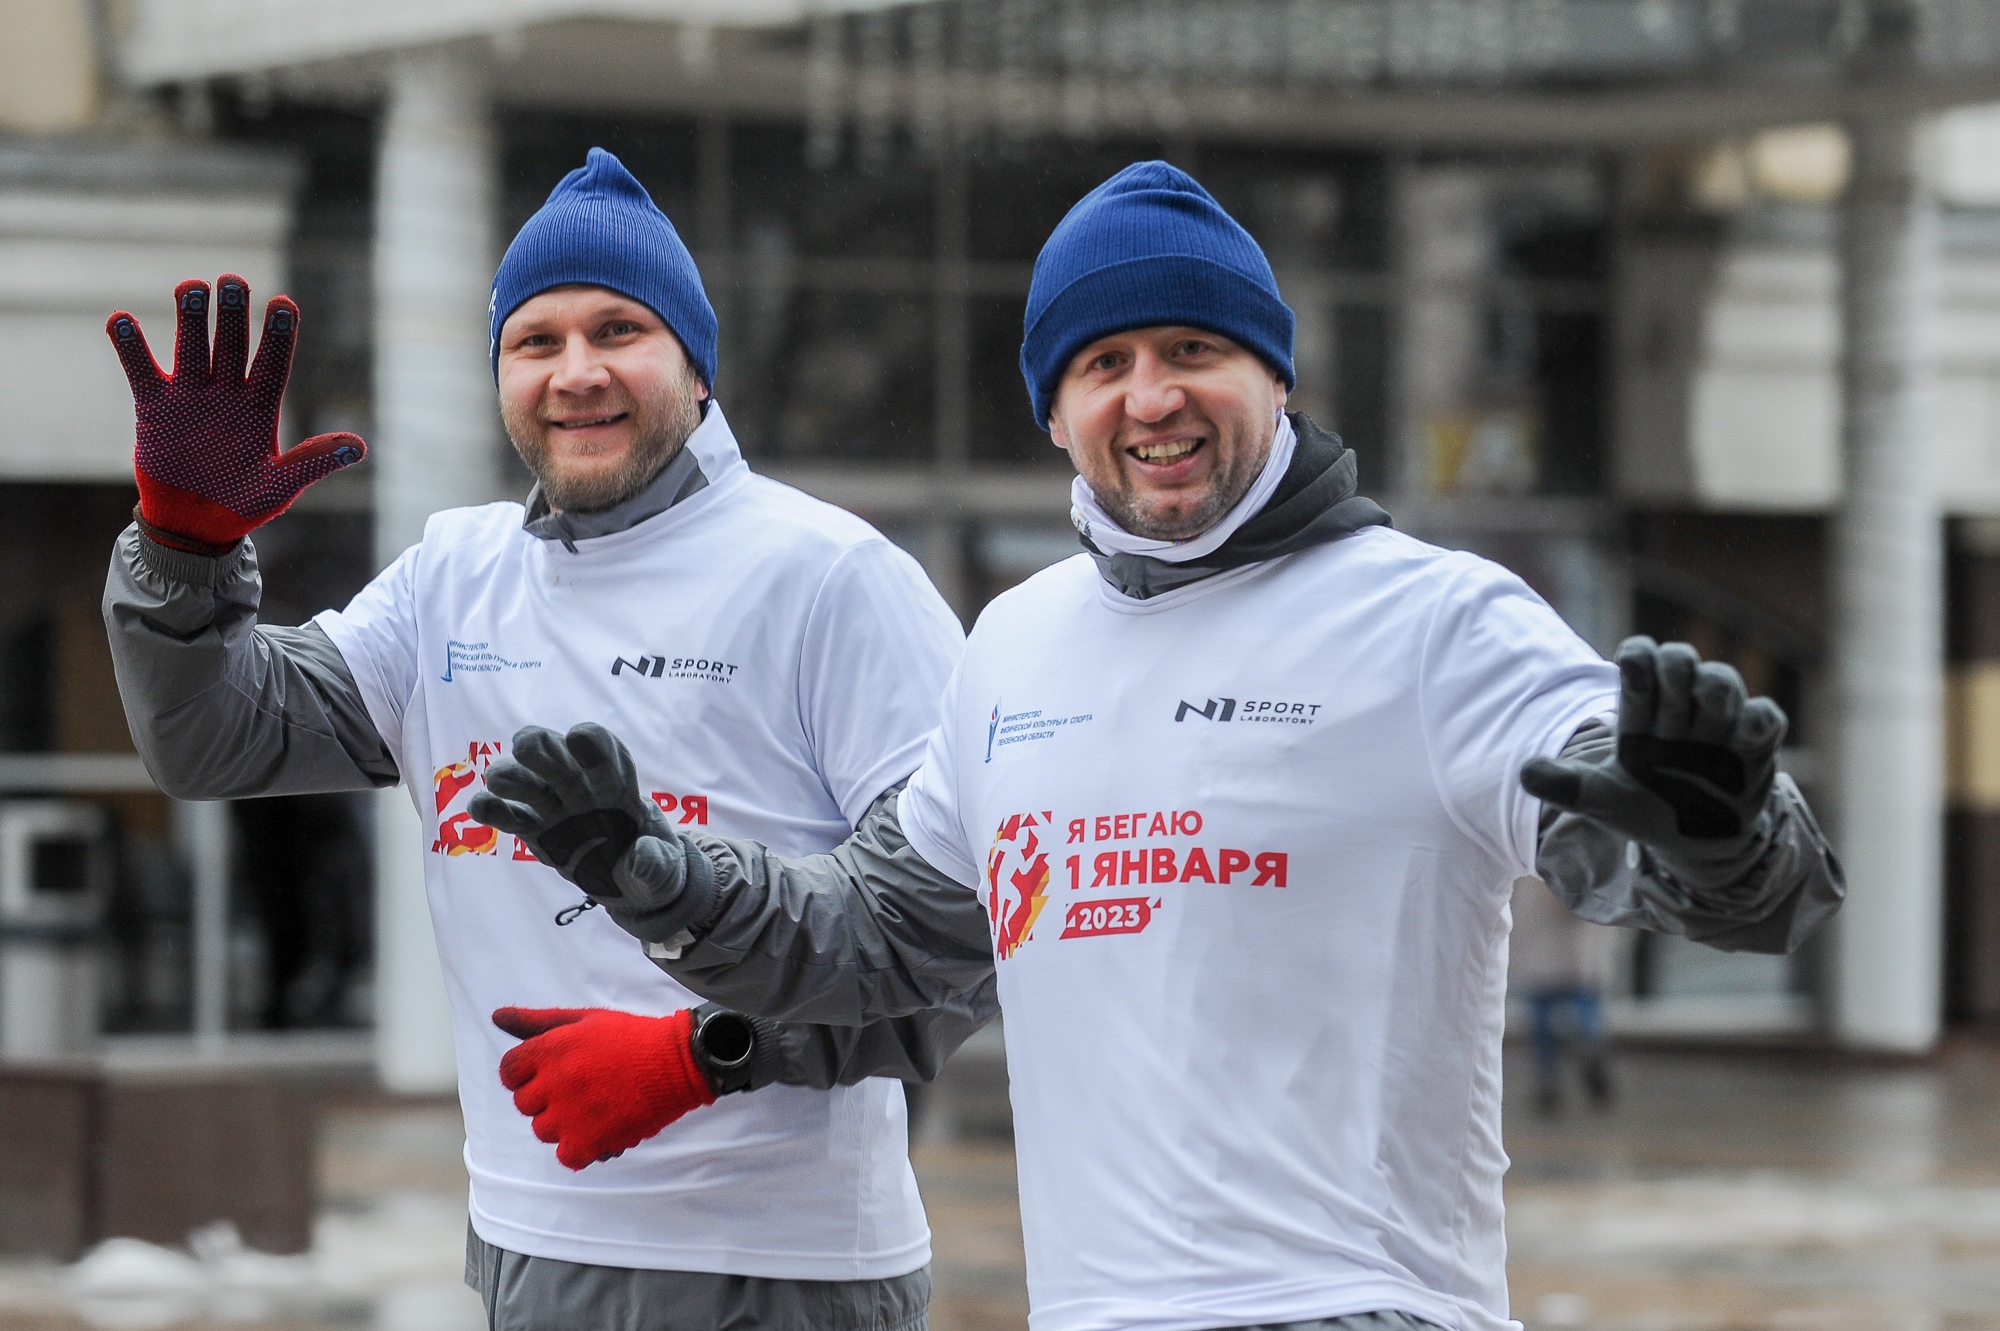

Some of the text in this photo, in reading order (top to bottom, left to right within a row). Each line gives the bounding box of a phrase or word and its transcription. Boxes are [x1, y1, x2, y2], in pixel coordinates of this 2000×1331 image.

[671, 658, 739, 676] SPORT
[668, 671, 732, 684] LABORATORY
[1002, 710, 1042, 723] МИНИСТЕРСТВО
[1243, 701, 1322, 716] SPORT
[1000, 721, 1032, 734] ФИЗИЧЕСКОЙ
[1032, 718, 1063, 729] КУЛЬТУРЫ
[1070, 714, 1093, 724] СПОРТА
[1240, 715, 1315, 725] LABORATORY
[997, 731, 1055, 746] ПЕНЗЕНСКОЙ ОБЛАСТИ
[1066, 810, 1203, 844] Я БЕГАЮ
[1066, 847, 1288, 890] 1 ЯНВАРЯ
[1079, 903, 1141, 931] 2023
